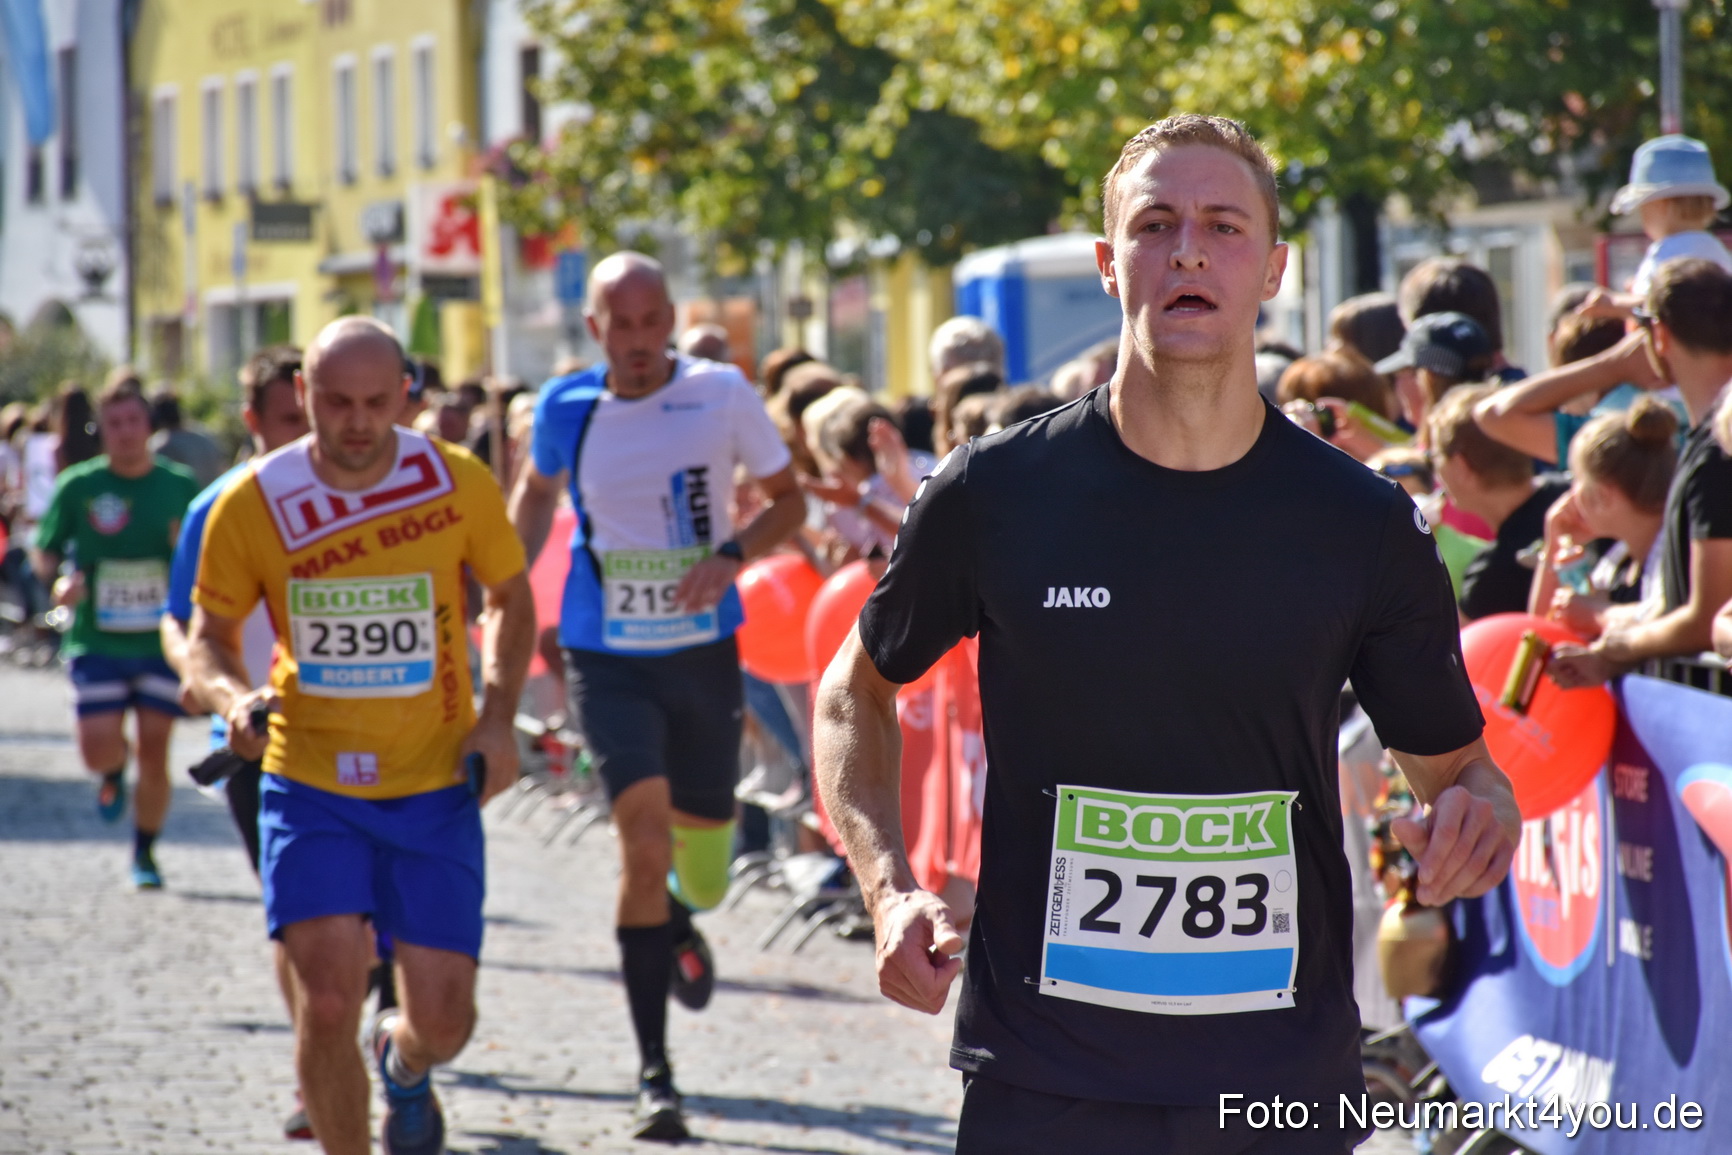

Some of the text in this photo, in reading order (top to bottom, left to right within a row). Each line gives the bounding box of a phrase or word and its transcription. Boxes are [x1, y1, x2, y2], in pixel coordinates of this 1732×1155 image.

[290, 504, 463, 580] MAX BÖGL
[301, 584, 416, 613] BOCK
[617, 584, 681, 614] 219
[1043, 587, 1111, 608] JAKO
[309, 619, 418, 657] 2390
[320, 666, 409, 685] ROBERT
[1077, 799, 1273, 851] BOCK
[1079, 868, 1270, 939] 2783
